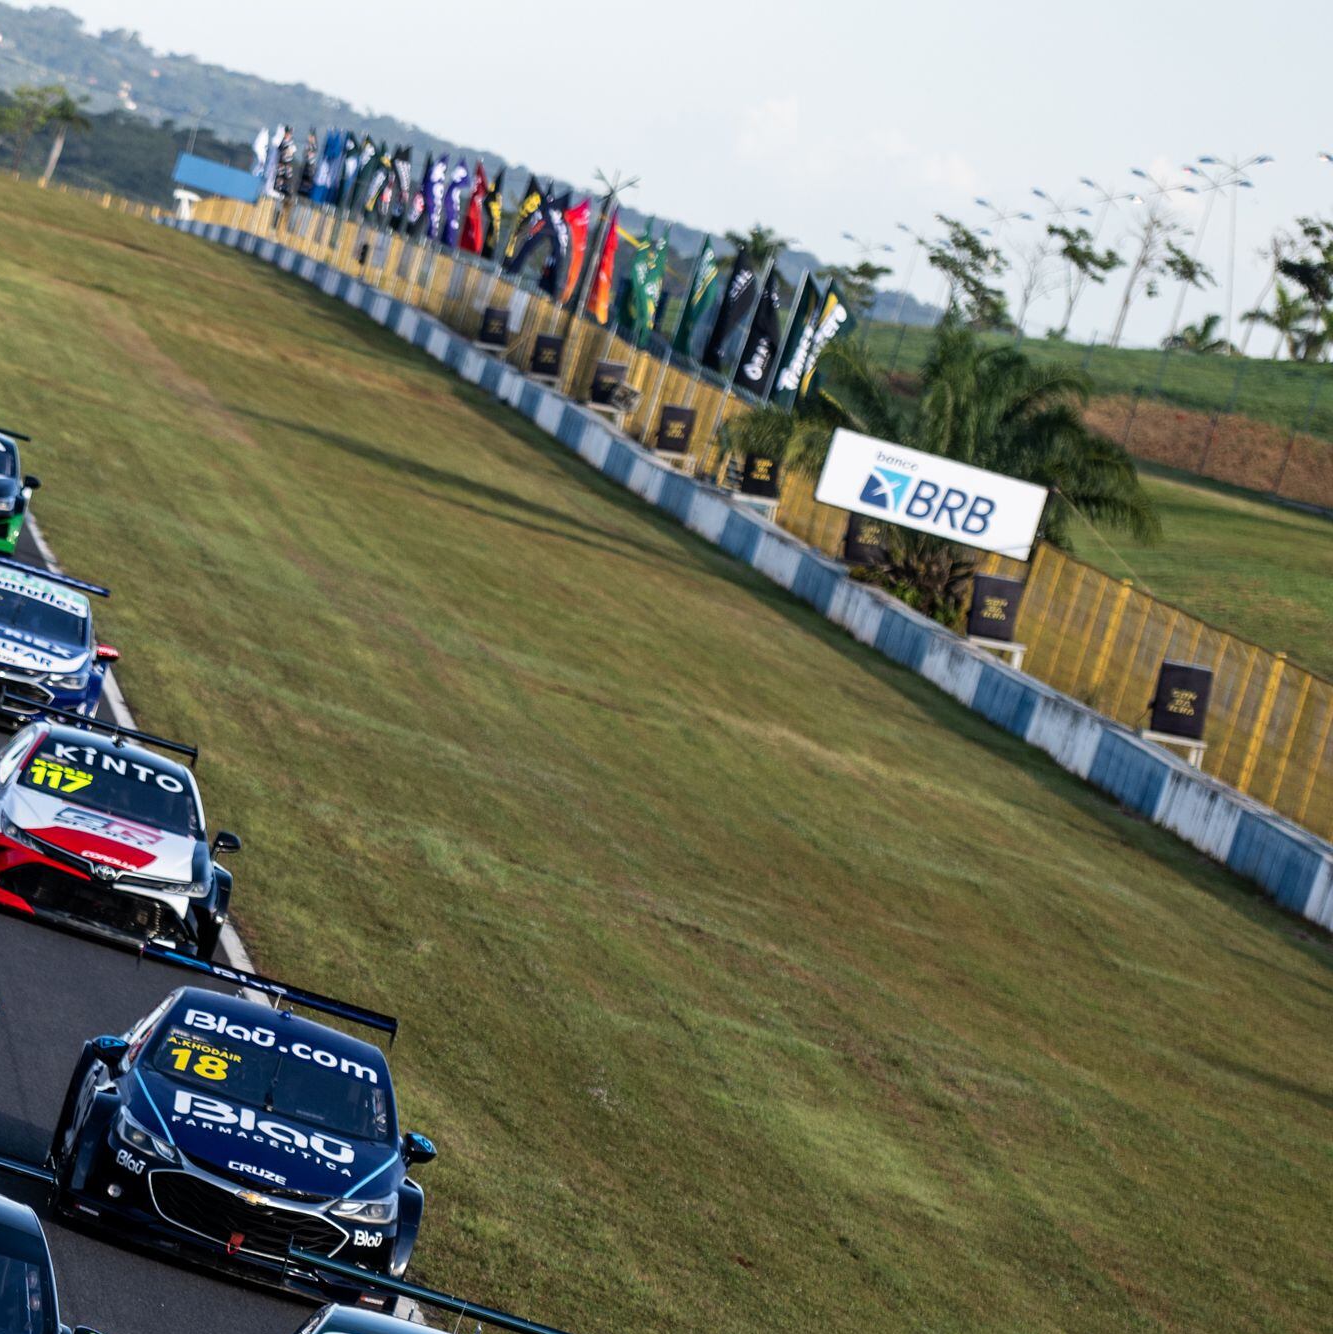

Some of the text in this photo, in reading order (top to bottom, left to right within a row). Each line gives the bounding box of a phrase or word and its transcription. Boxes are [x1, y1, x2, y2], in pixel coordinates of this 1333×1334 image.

[905, 480, 996, 536] BRB
[31, 766, 92, 793] 117
[54, 743, 183, 793] KINTO
[168, 1036, 242, 1063] A.KHODAIR
[170, 1049, 229, 1081] 18
[228, 1160, 287, 1185] CRUZE
